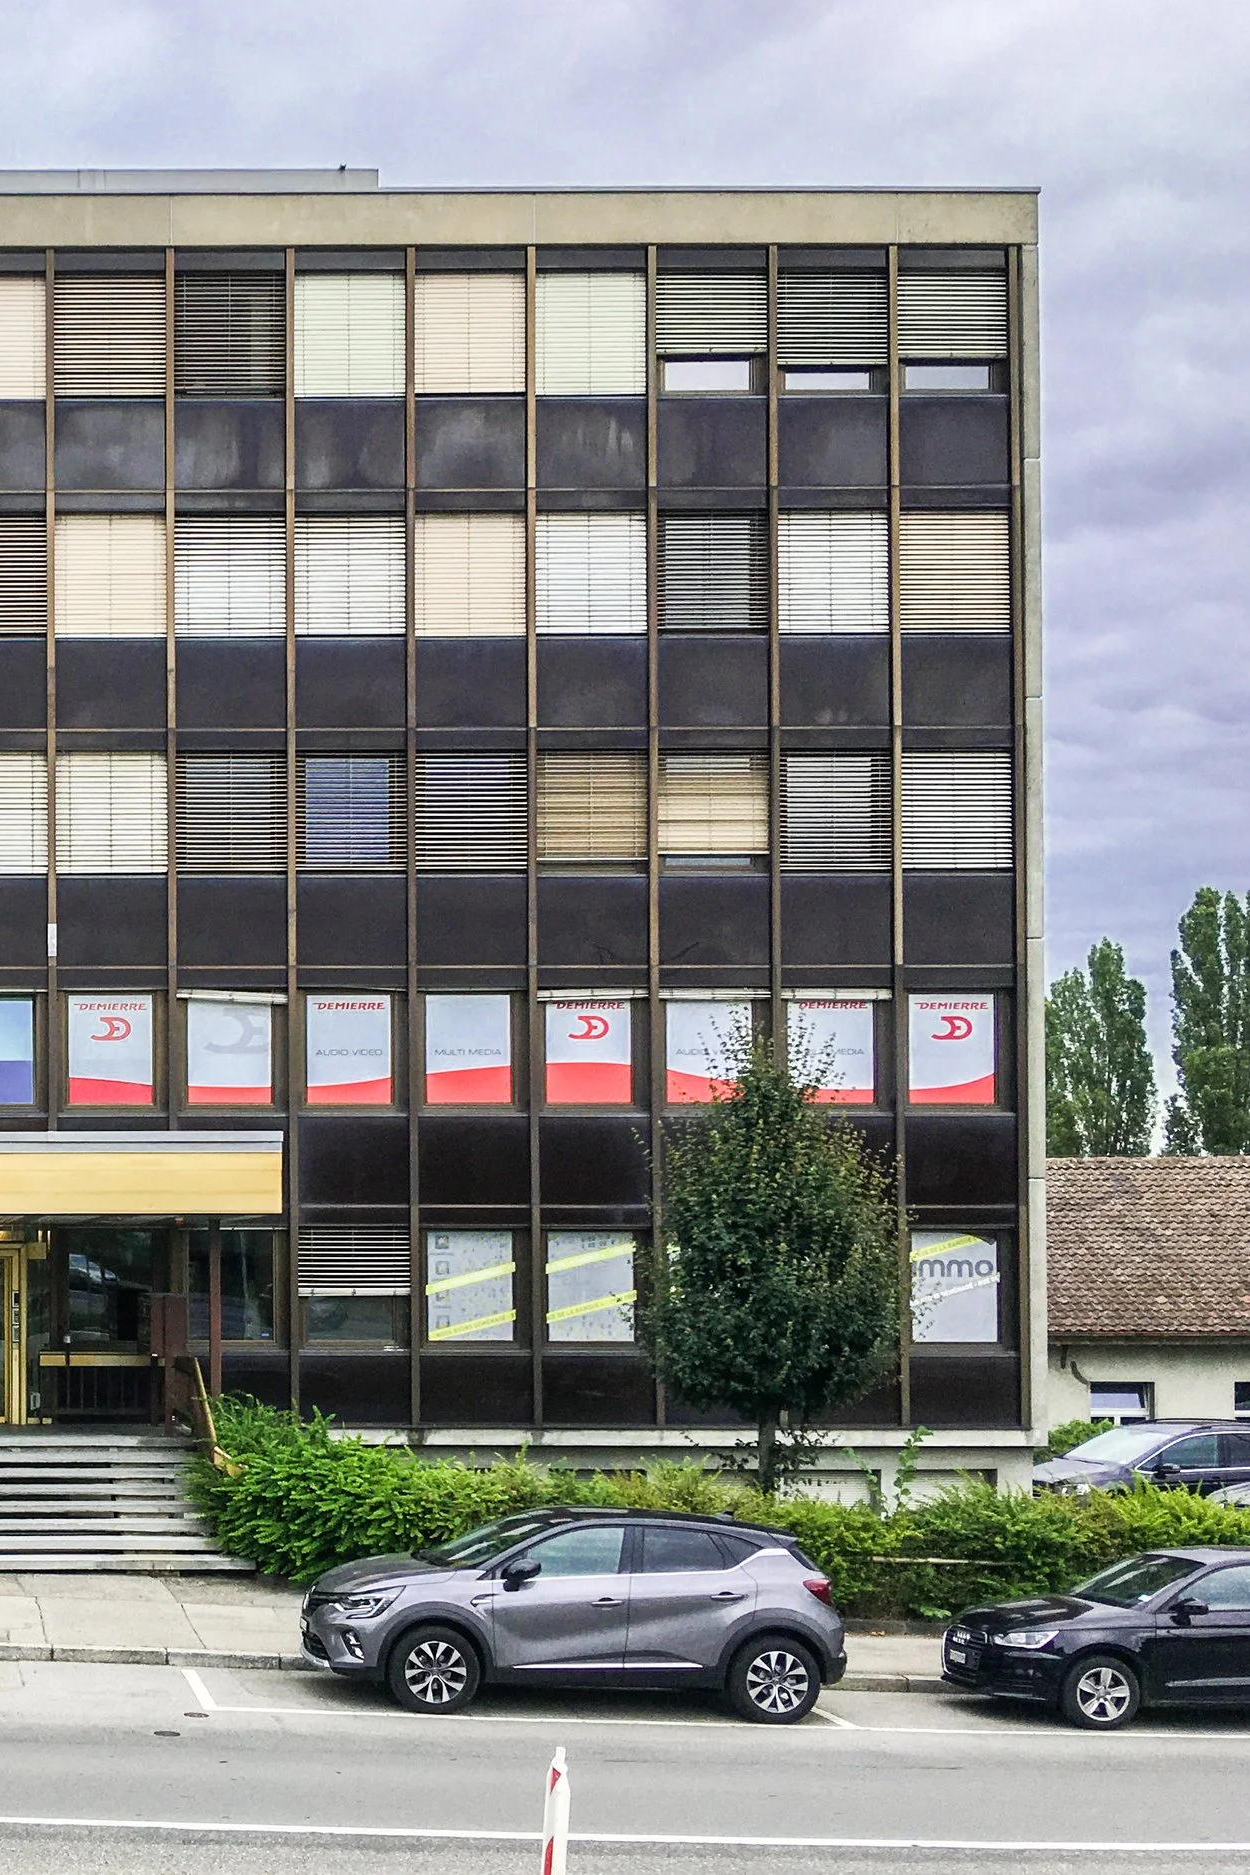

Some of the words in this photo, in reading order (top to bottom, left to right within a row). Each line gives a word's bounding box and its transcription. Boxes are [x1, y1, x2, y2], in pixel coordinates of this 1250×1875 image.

[74, 1003, 147, 1011] DEMIERRE
[312, 1002, 385, 1010] DEMIERRE
[551, 1001, 625, 1010] DEMIERRE
[798, 1001, 867, 1009] DEMIERRE
[914, 1002, 988, 1010] DEMIERRE
